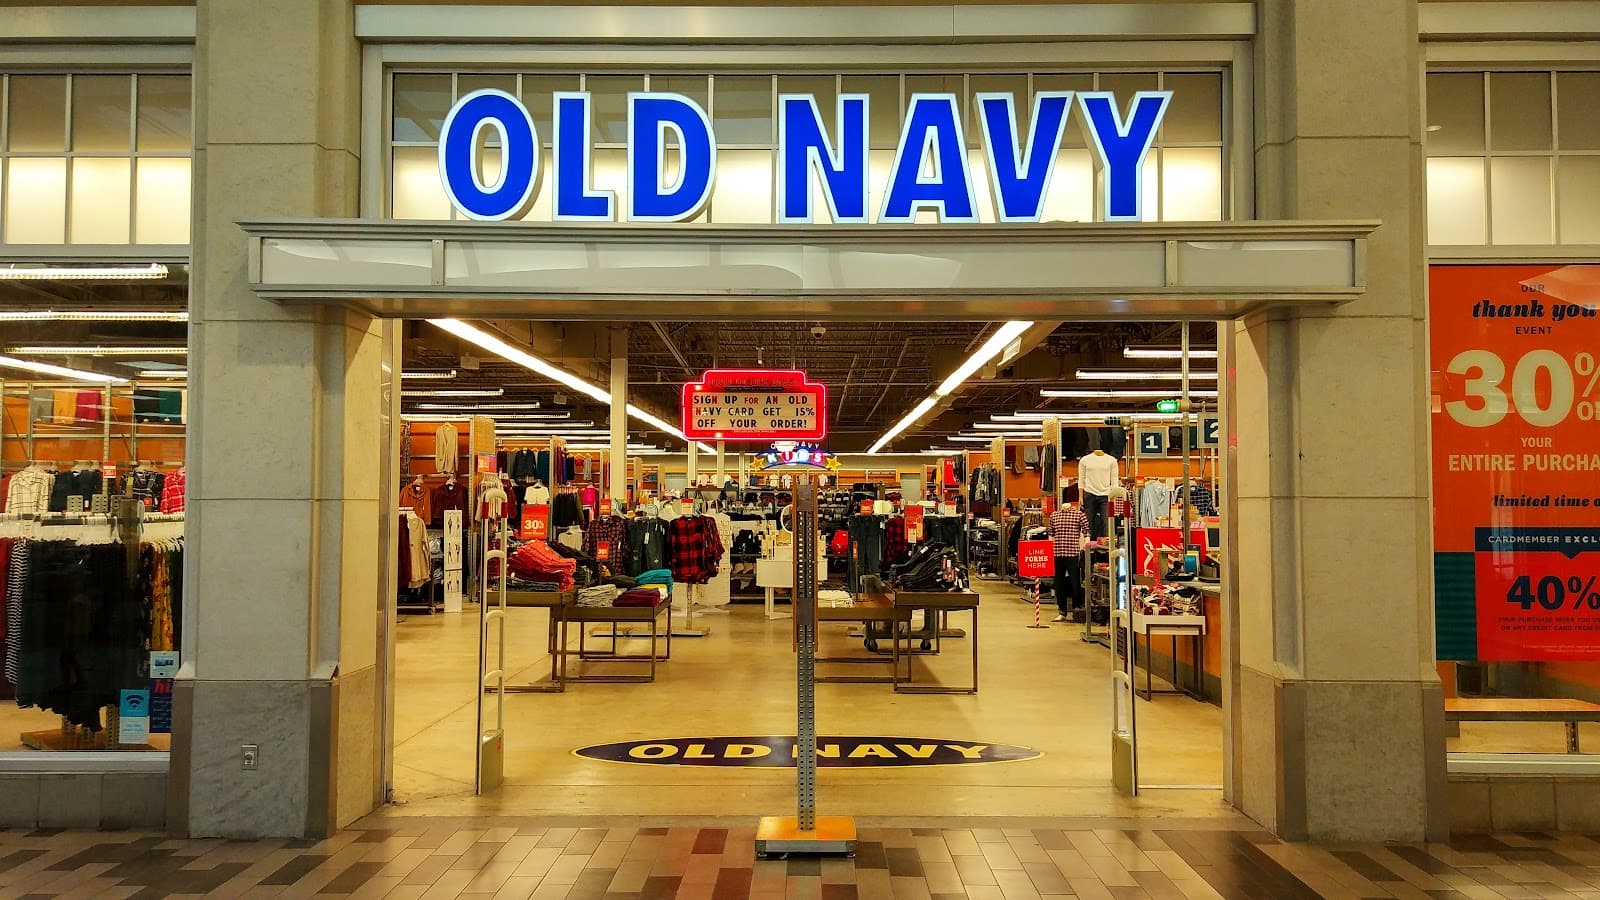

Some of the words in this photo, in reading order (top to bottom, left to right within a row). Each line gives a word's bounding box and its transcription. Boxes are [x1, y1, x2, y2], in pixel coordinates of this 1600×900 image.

[438, 87, 717, 222] OLD
[777, 90, 1174, 224] NAVY
[1521, 284, 1545, 293] OUR
[1472, 299, 1544, 318] thank
[1552, 303, 1597, 321] you
[1515, 326, 1553, 335] EVENT
[693, 395, 718, 404] SIGN
[724, 395, 738, 404] UP
[744, 396, 759, 404] FOR
[765, 395, 778, 404] AN
[788, 395, 808, 404] OLD
[695, 407, 722, 416] NAVY
[728, 407, 754, 416] CARD
[762, 407, 781, 416] GET
[795, 407, 815, 416] 15%
[697, 419, 716, 428] OFF
[730, 419, 757, 428] YOUR
[770, 419, 807, 428] ORDER!
[1209, 422, 1219, 438] 2
[1145, 435, 1159, 449] 1
[1521, 437, 1553, 448] YOUR
[1449, 454, 1515, 471] ENTIRE
[1523, 454, 1600, 471] PURCHA
[1494, 495, 1550, 507] limited
[1554, 495, 1590, 507] time
[1488, 535, 1560, 543] CARDMEMBER
[1565, 535, 1600, 543] EXCL
[1507, 575, 1600, 610] 40%
[628, 744, 772, 758] OLD
[791, 744, 990, 758] NAVY
